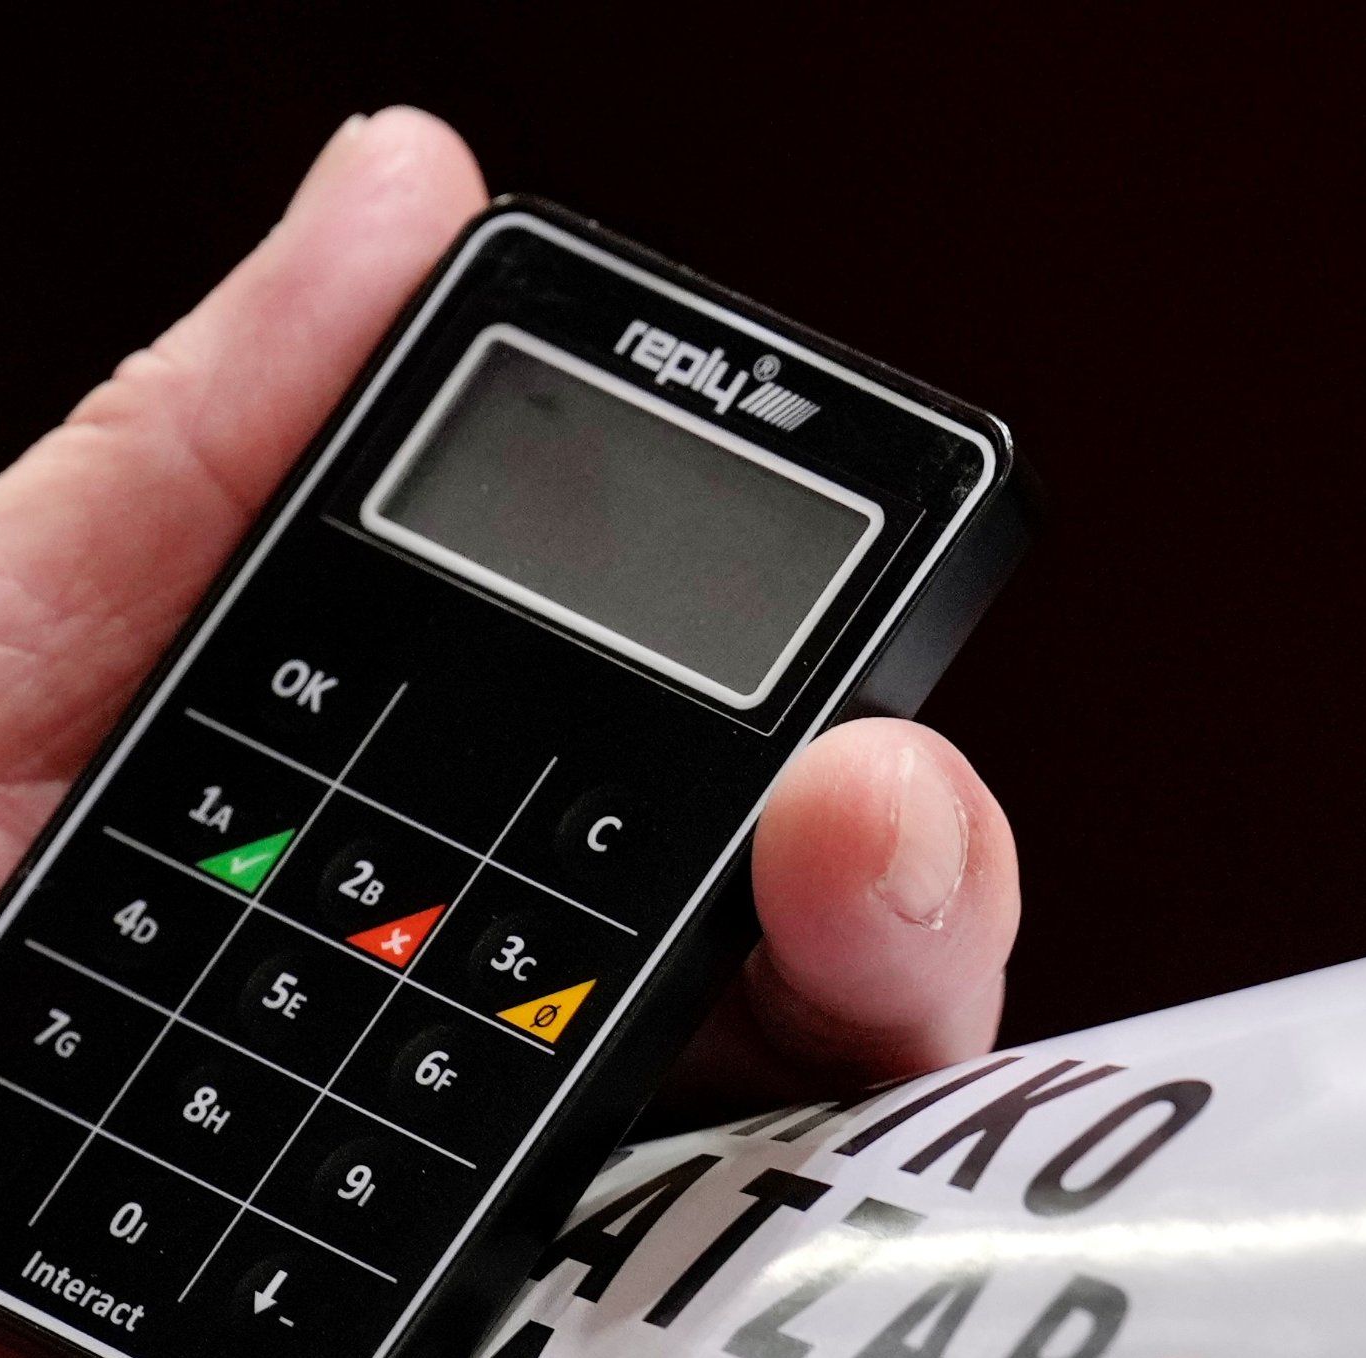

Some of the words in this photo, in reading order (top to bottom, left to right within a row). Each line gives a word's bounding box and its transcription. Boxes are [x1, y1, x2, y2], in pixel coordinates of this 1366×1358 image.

[271, 659, 338, 713] OK
[188, 786, 235, 833] 1A
[587, 816, 623, 852] C
[338, 860, 385, 907] 2B
[113, 899, 159, 945] 4D
[490, 935, 537, 982] 3C
[262, 973, 308, 1020] 5E
[34, 1008, 81, 1058] 7G
[415, 1050, 458, 1093] 6F
[183, 1086, 231, 1134] 8H
[730, 1055, 1213, 1217] IKO
[21, 1251, 145, 1332] Interact
